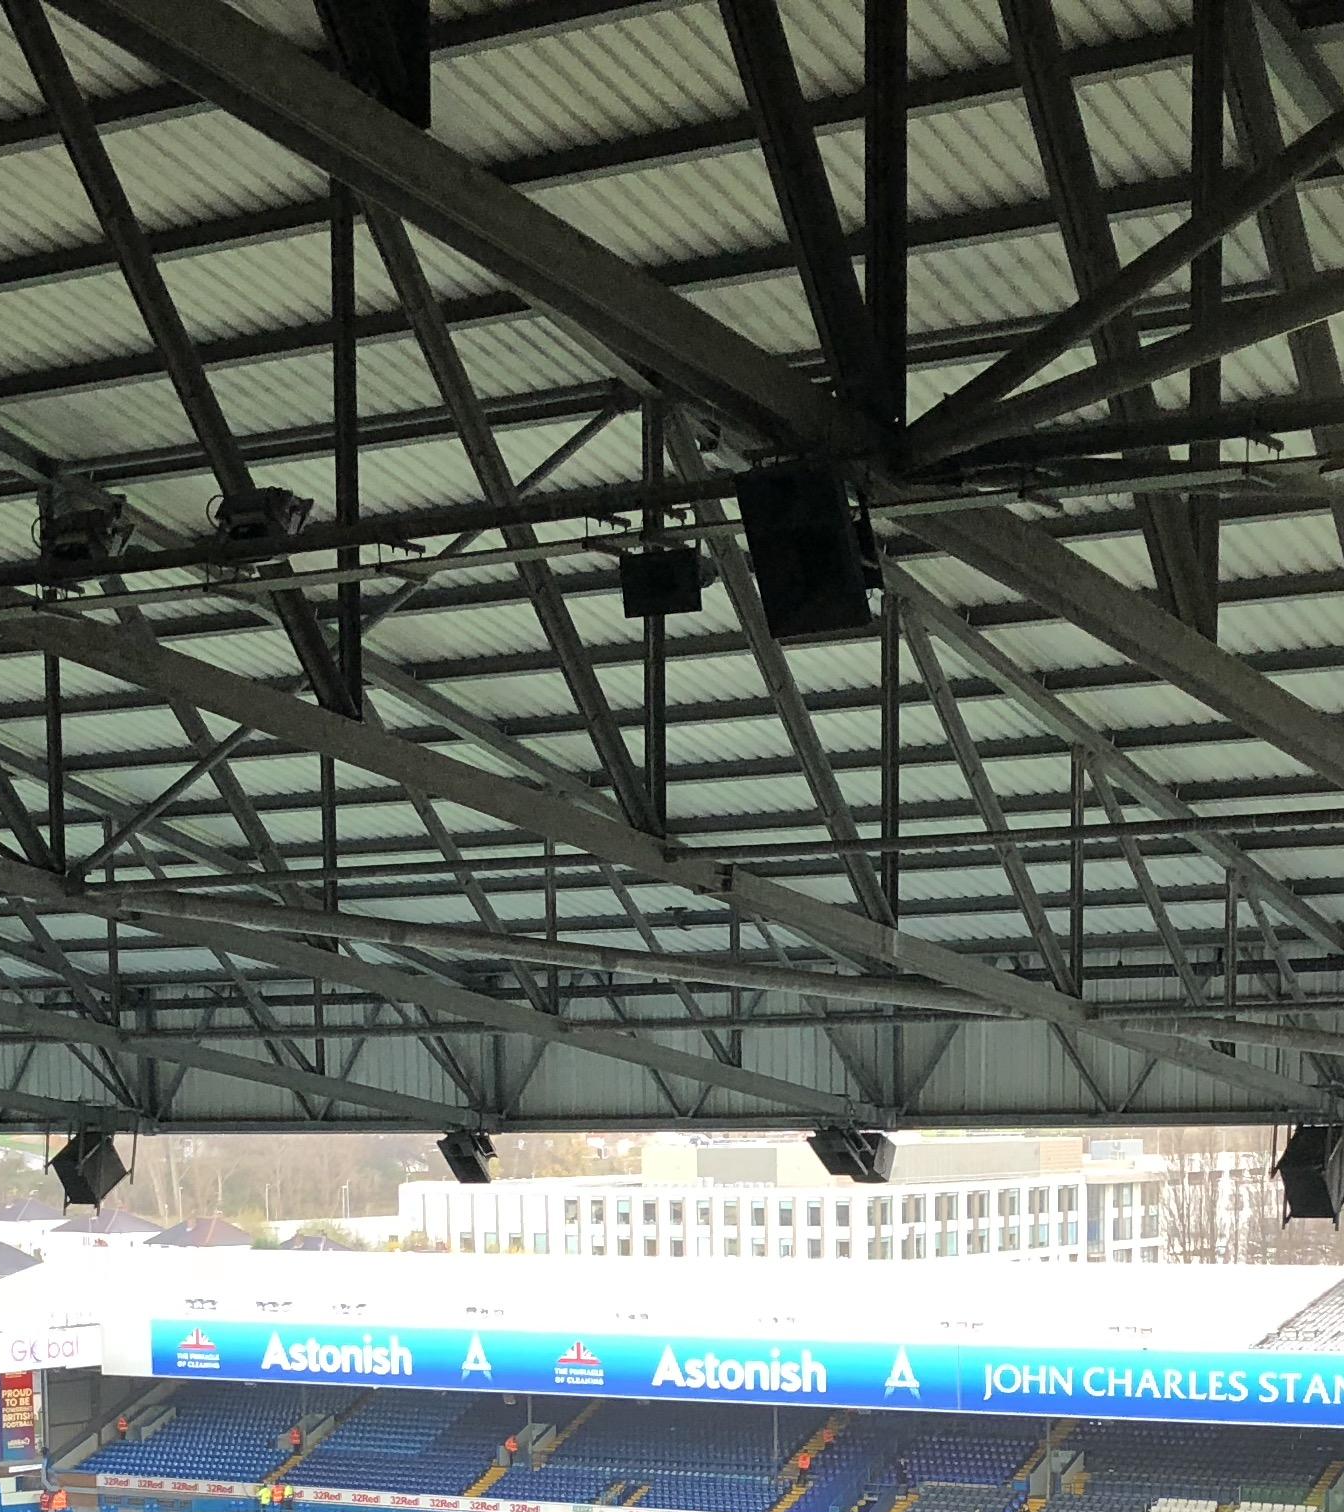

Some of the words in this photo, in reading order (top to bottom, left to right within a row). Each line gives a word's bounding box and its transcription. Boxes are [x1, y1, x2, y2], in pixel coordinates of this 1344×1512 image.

[261, 1330, 412, 1375] Astonish
[652, 1344, 826, 1393] Astonish
[1, 1388, 32, 1399] PROUD
[5, 1398, 18, 1407] TO
[19, 1397, 31, 1406] BE
[983, 1363, 1073, 1400] JOHN
[1083, 1366, 1248, 1402] CHARLES
